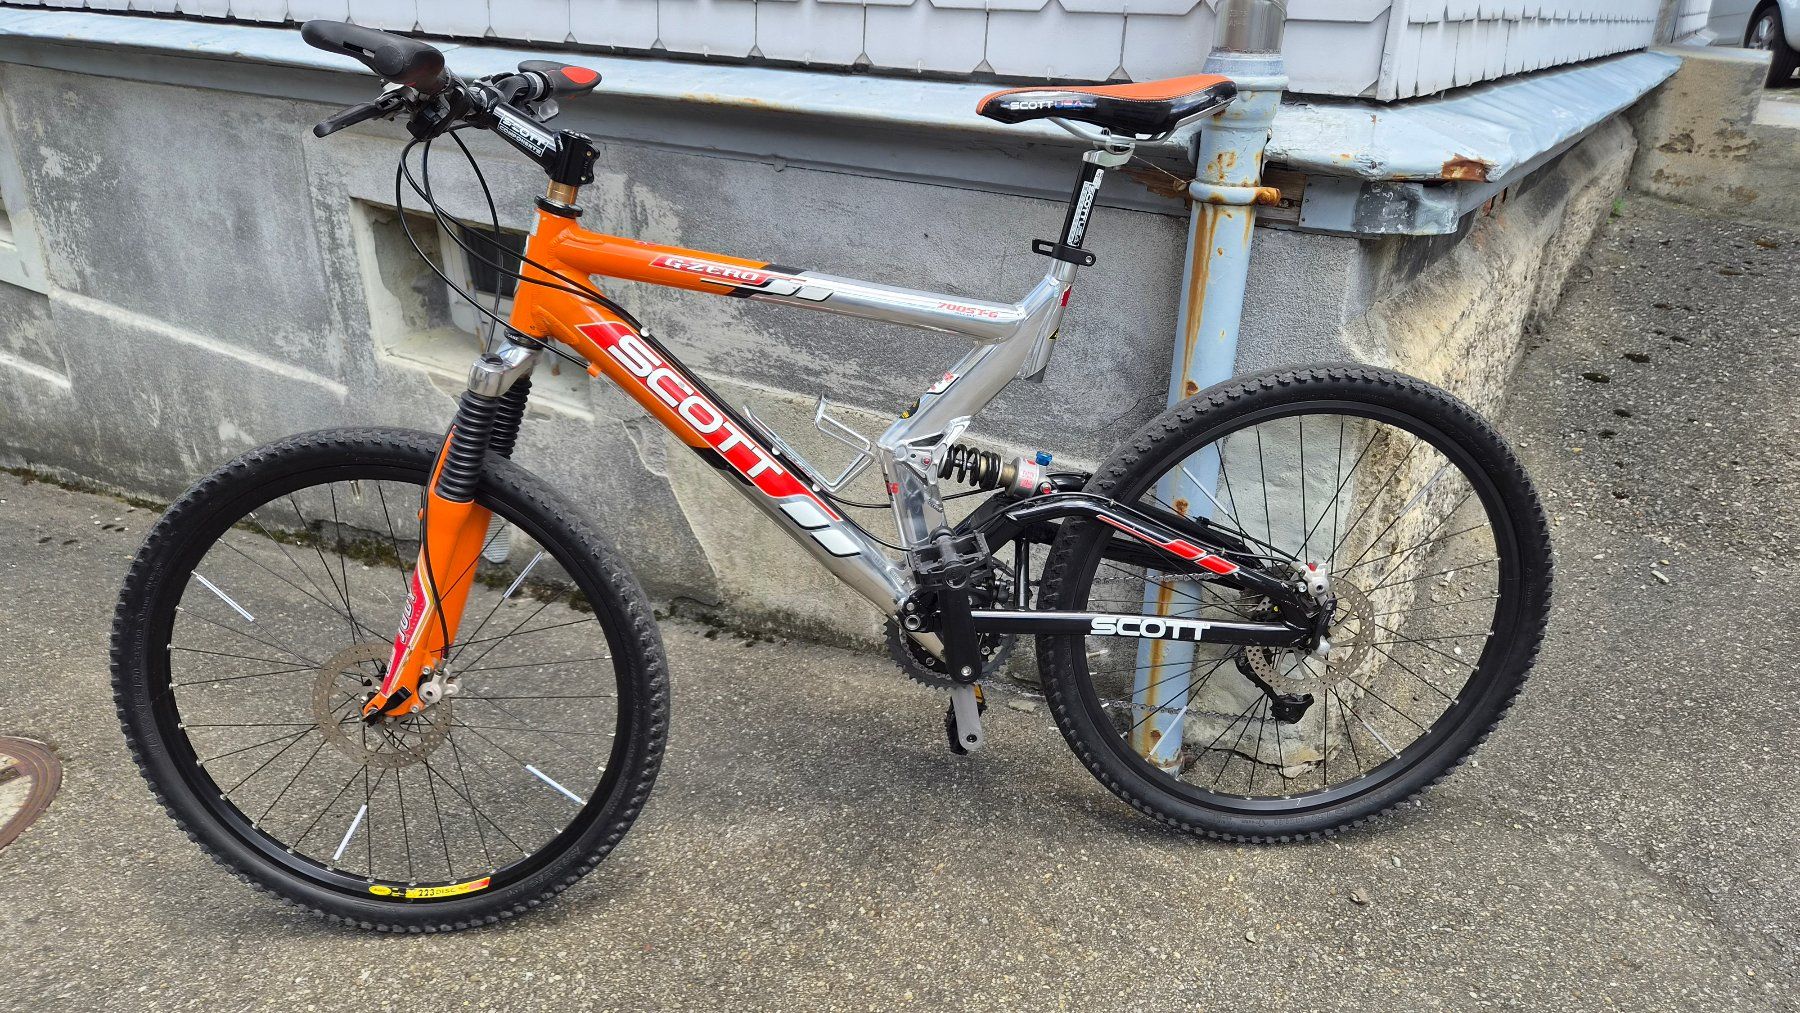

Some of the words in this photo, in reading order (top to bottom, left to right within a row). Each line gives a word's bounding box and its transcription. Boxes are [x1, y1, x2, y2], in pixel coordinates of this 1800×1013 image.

[1010, 101, 1053, 110] SCOTT
[664, 258, 760, 281] G-ZERO
[607, 334, 784, 478] SCOTT
[1091, 617, 1210, 640] SCOTT
[418, 888, 435, 898] 223
[435, 887, 456, 896] DISC
